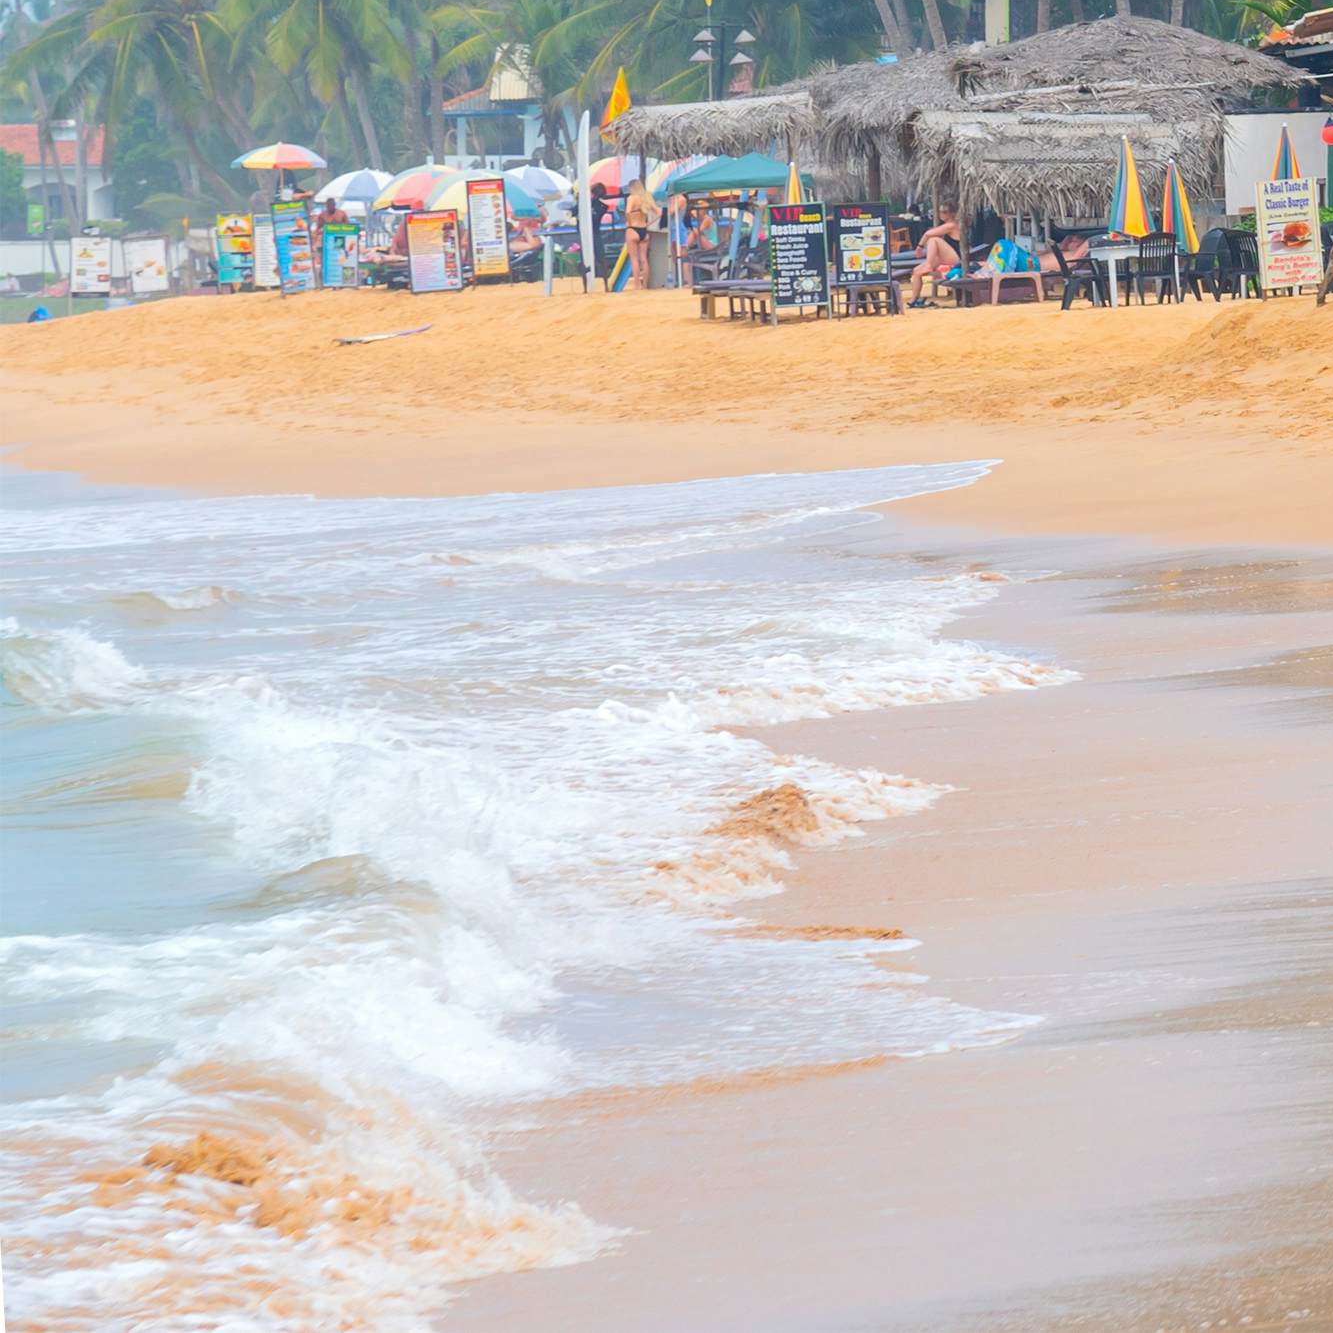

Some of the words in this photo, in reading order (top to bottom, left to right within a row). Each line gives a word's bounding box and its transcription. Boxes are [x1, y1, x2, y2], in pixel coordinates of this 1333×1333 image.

[1264, 183, 1269, 194] A
[1270, 182, 1283, 193] Real
[1284, 181, 1301, 192] Taste
[1265, 199, 1287, 210] Classic
[1288, 197, 1309, 210] Burger
[771, 207, 803, 221] VIP
[841, 208, 862, 218] VIP
[840, 218, 882, 227] Restaurant
[771, 223, 823, 236] Restaurant
